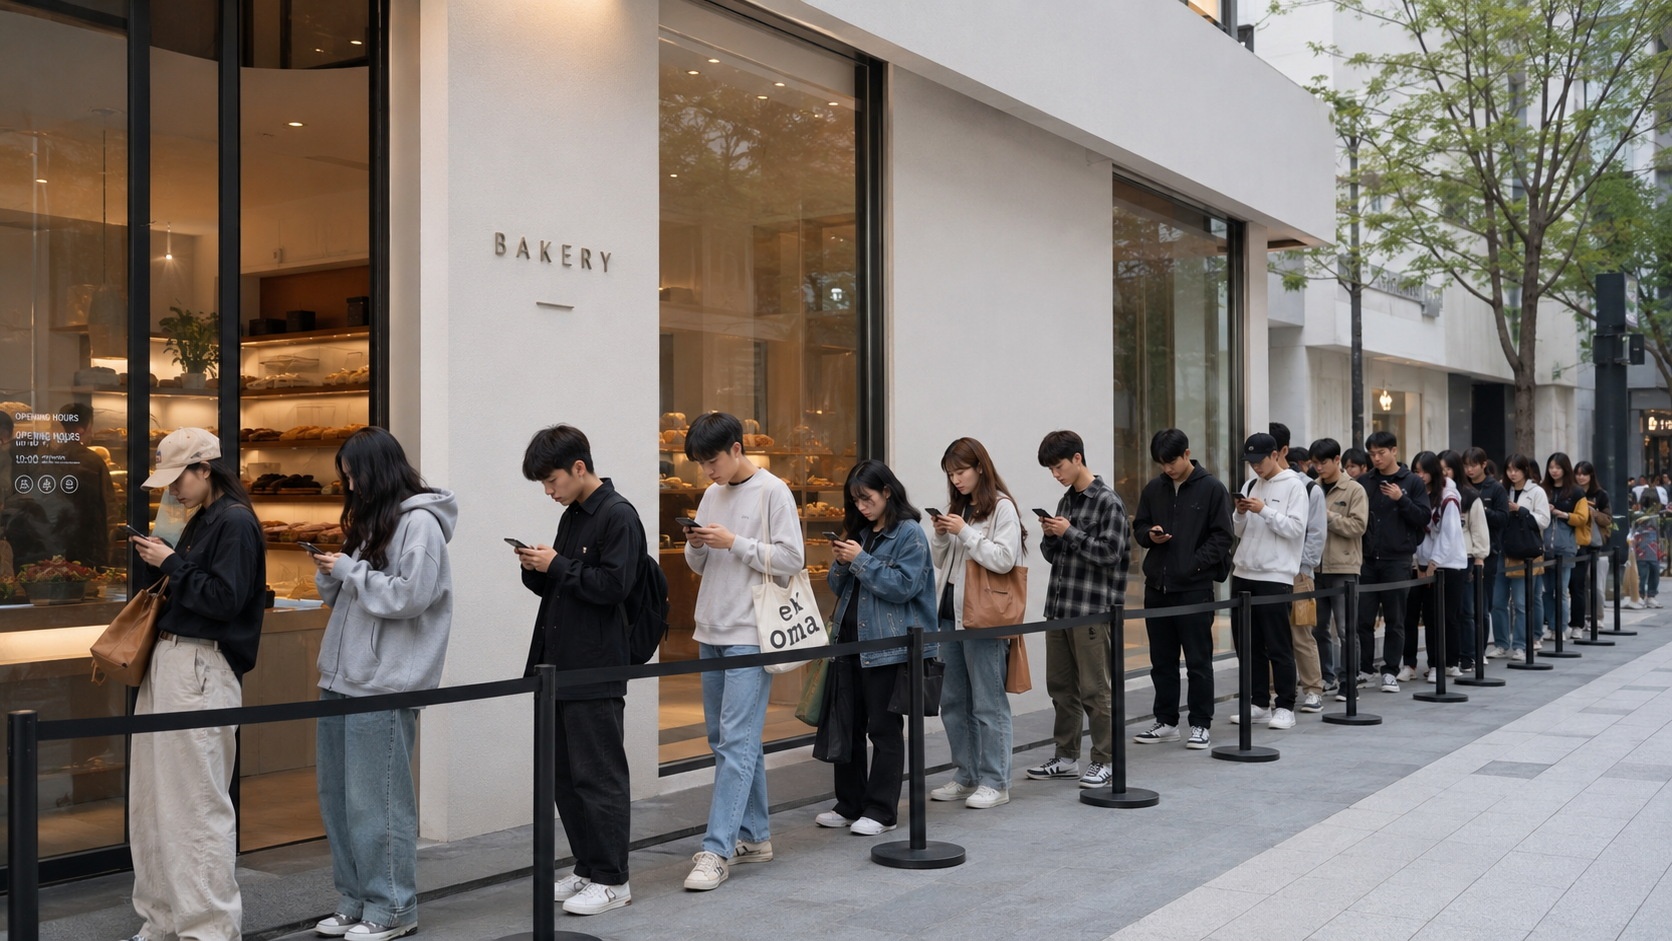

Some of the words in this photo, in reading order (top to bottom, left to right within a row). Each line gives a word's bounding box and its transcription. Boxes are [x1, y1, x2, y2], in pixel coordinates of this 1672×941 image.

[495, 232, 611, 273] BAKERY
[52, 413, 79, 422] HOURS
[770, 615, 820, 649] oma
